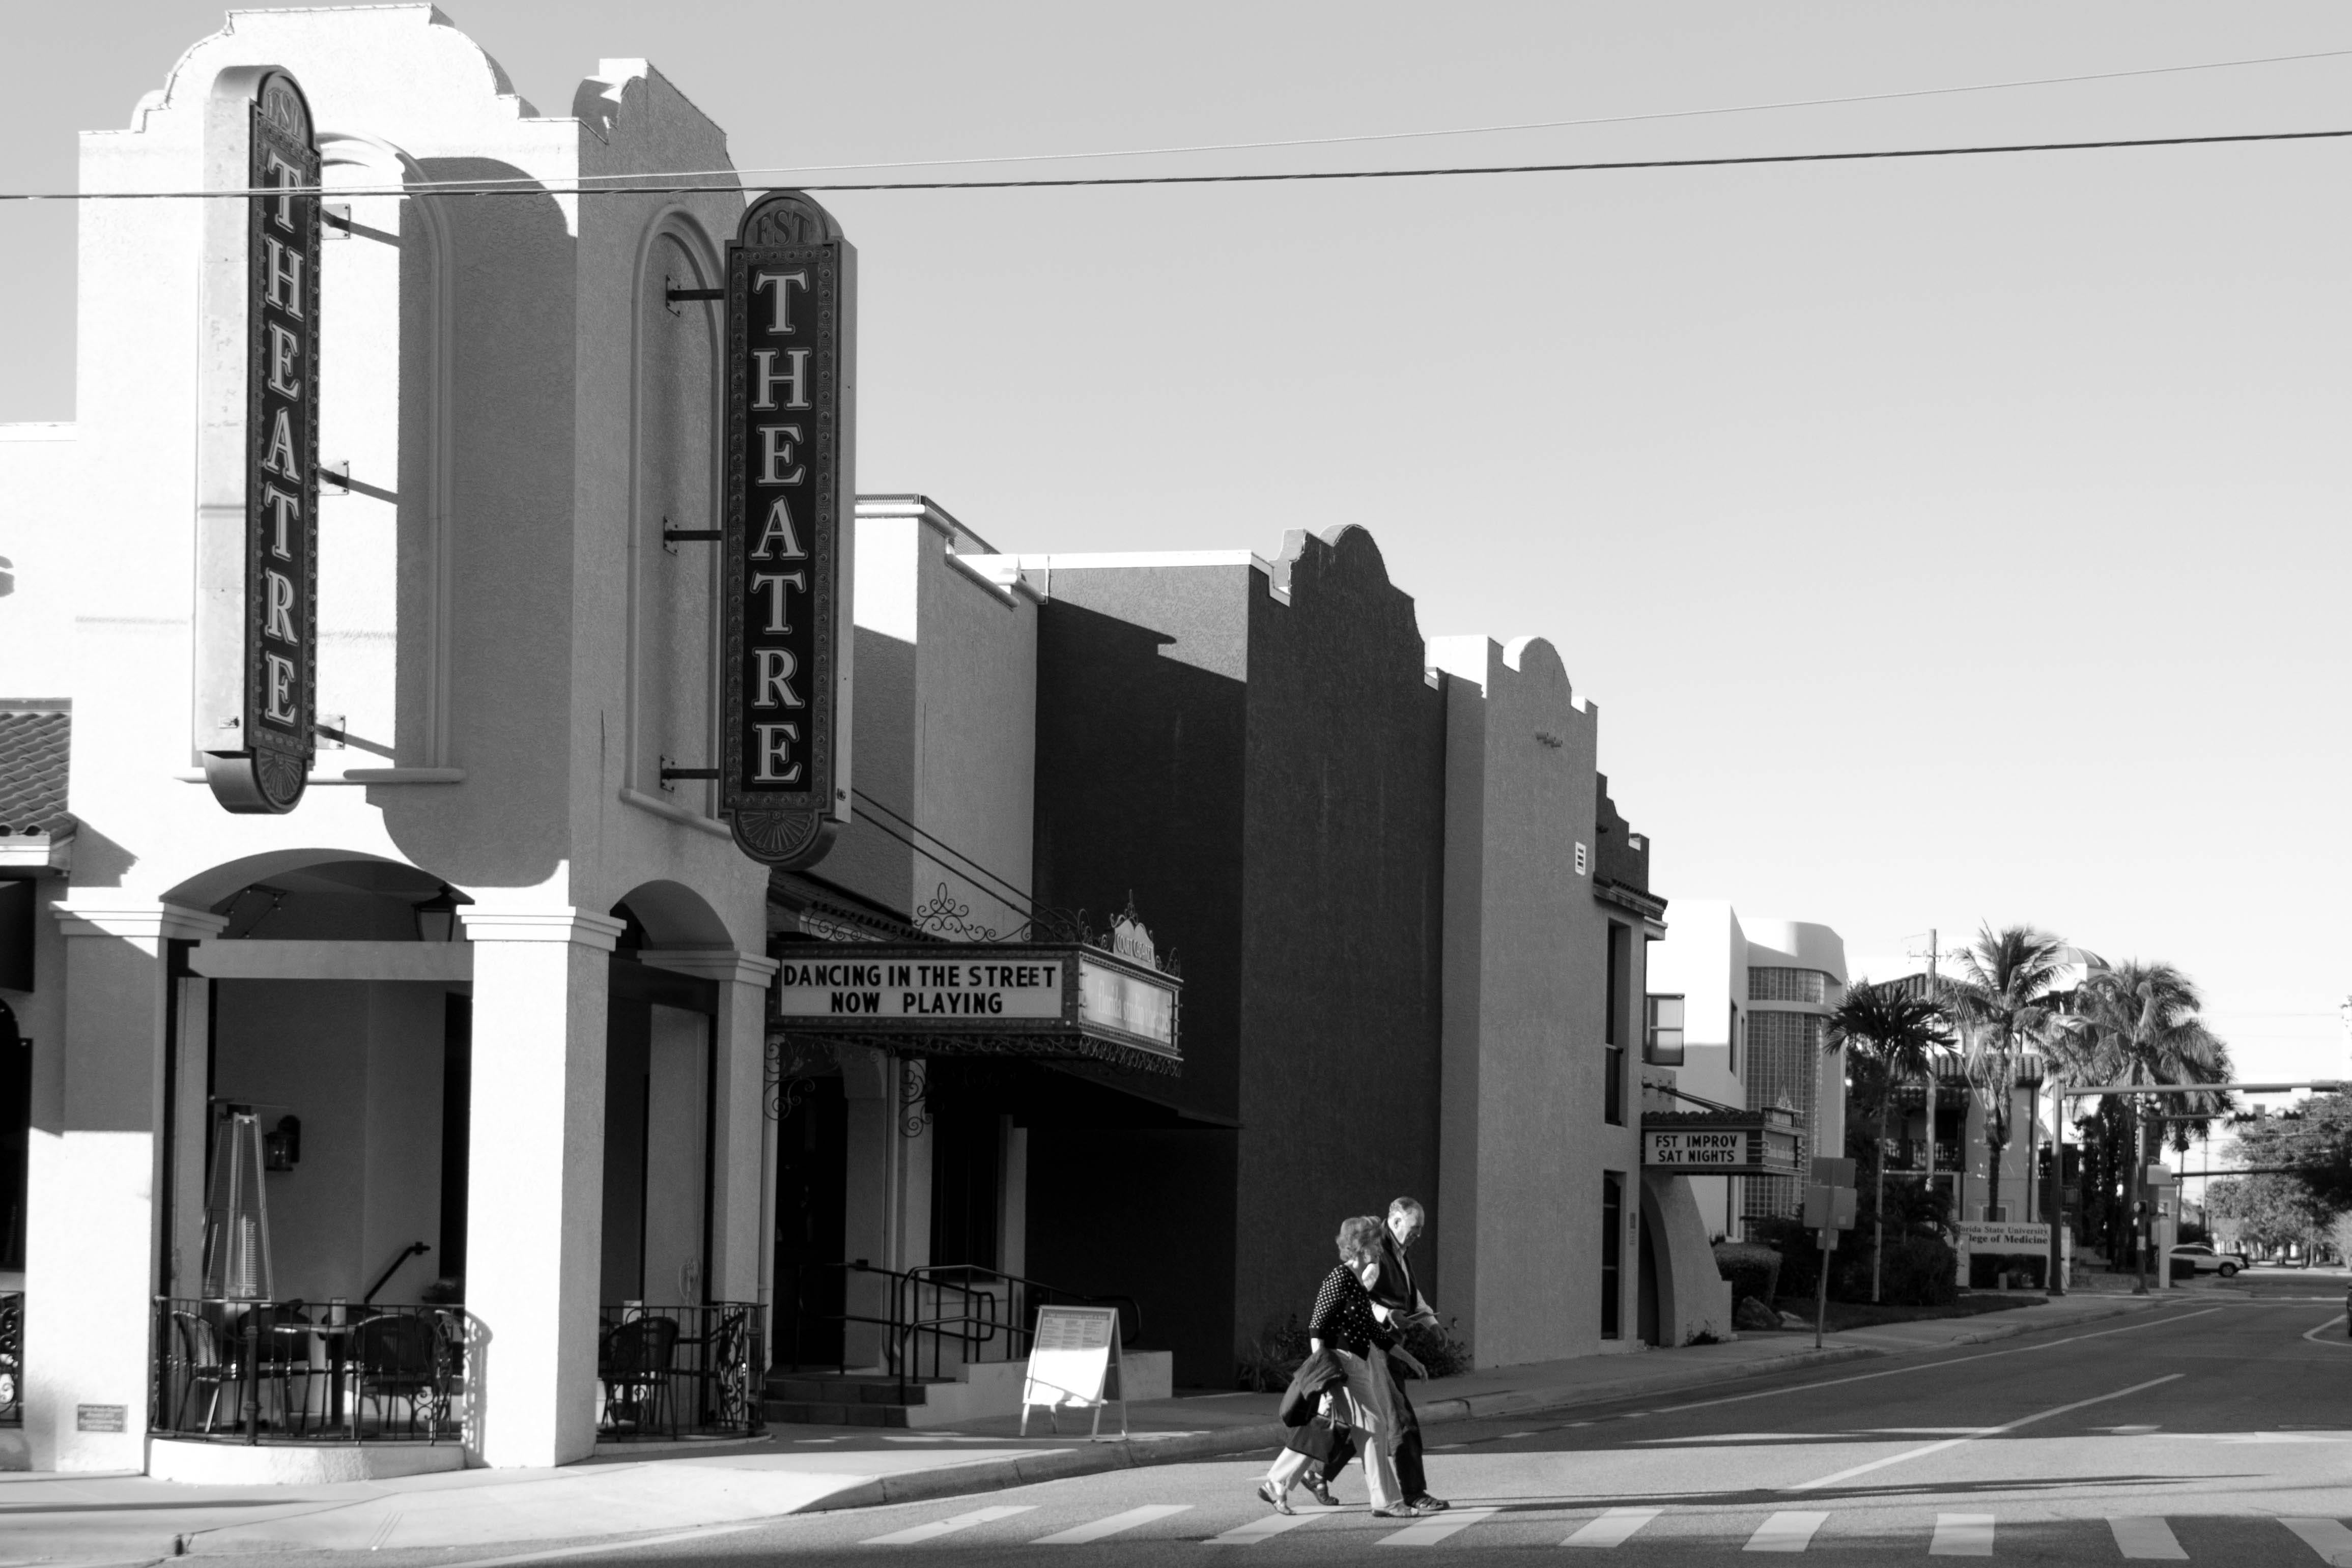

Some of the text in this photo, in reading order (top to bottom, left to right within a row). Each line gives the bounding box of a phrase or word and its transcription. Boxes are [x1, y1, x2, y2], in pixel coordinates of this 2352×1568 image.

[755, 208, 813, 246] FST
[264, 152, 305, 727] THEATRE
[749, 269, 813, 783] THEATRE
[784, 965, 1056, 987] DANCING IN THE STREET
[832, 992, 1002, 1014] NOW PLAYING
[1656, 1135, 1737, 1147] FST IMPROV
[1659, 1150, 1734, 1162] SAT NIGHTS
[1969, 1234, 1988, 1244] lege
[2004, 1235, 2048, 1244] Medicine
[2008, 1227, 2048, 1235] University
